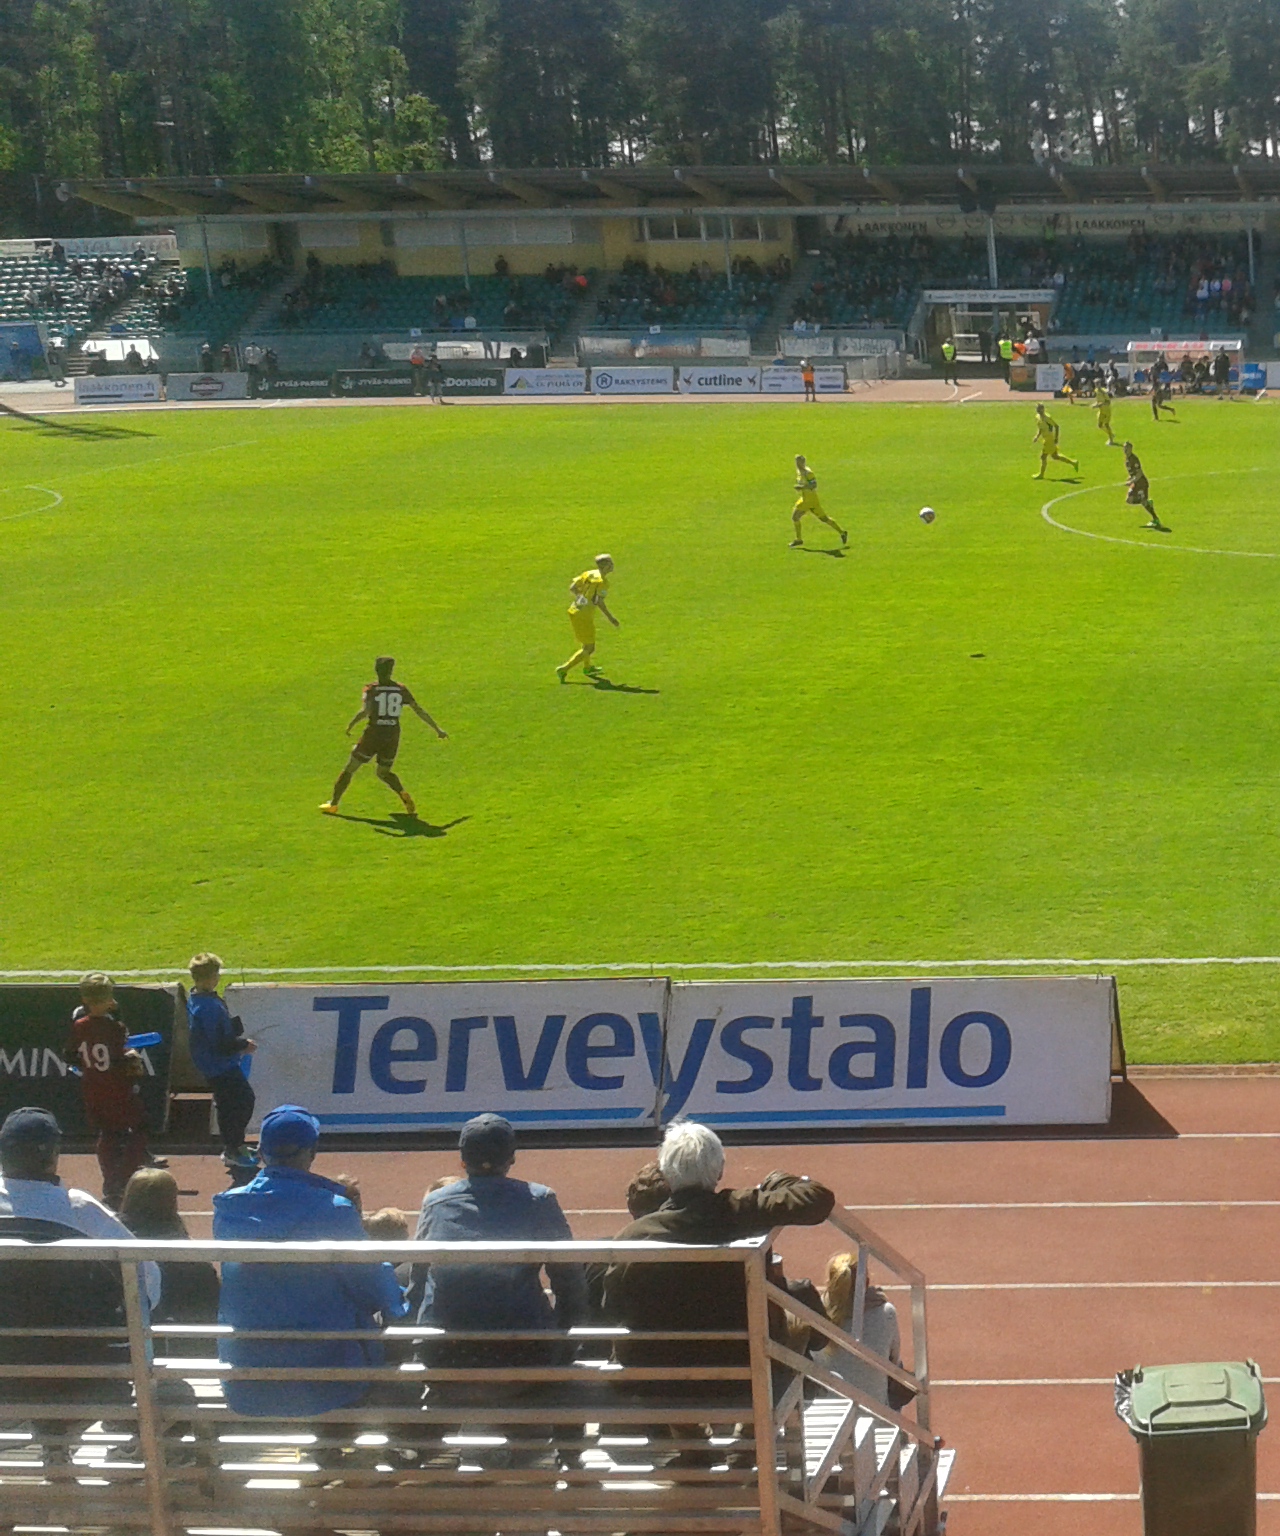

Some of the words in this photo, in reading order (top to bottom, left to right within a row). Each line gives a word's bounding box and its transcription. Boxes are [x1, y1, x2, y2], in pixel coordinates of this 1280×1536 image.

[428, 377, 497, 387] cDonald's
[697, 372, 742, 386] cutline
[375, 692, 402, 717] 18
[78, 1041, 110, 1072] 19
[313, 986, 1012, 1119] Terveystalo
